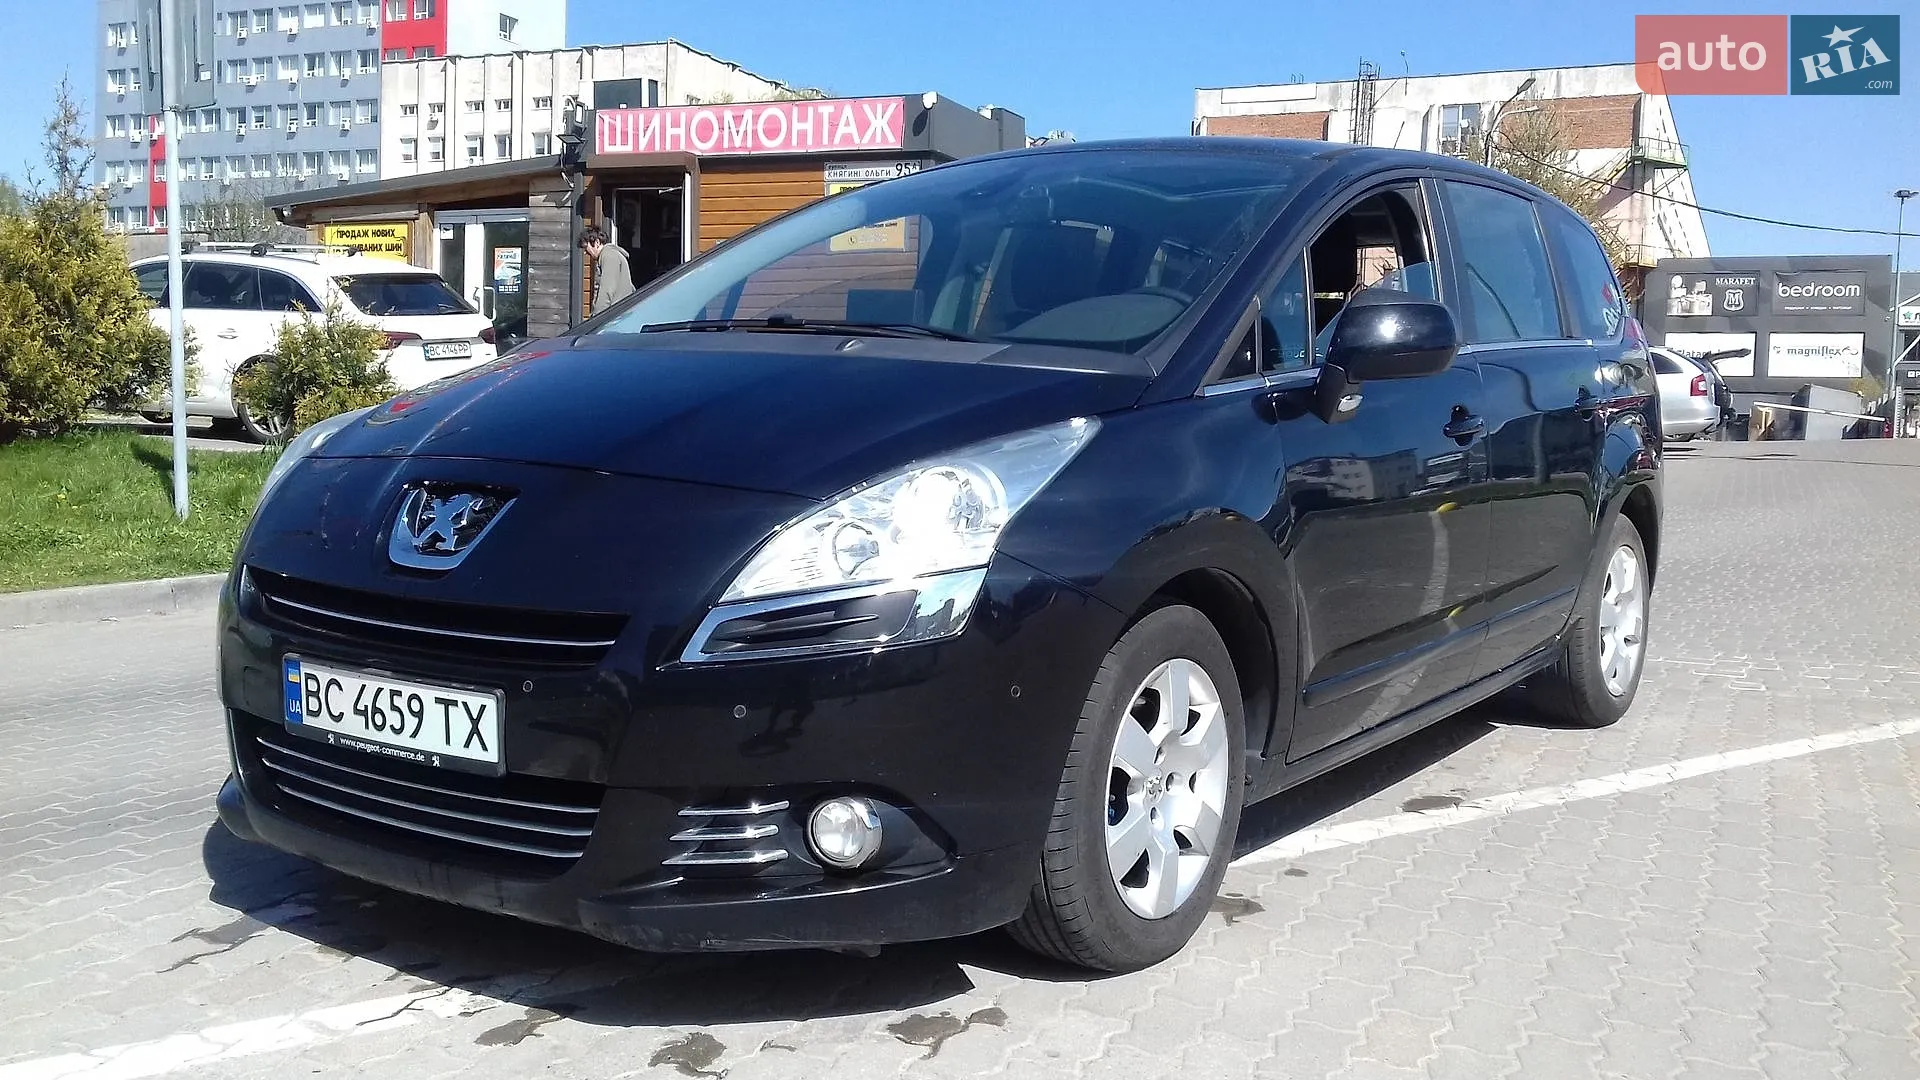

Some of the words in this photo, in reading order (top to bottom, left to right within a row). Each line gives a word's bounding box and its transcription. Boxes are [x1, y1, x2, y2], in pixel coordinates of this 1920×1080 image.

[603, 102, 897, 150] ШИНОМОНТАЖ
[827, 169, 861, 178] КНЯГИНІ
[864, 168, 891, 177] ОЛЬГИ
[336, 228, 370, 240] ПРОДАЖ
[371, 228, 396, 238] НОВИХ
[385, 243, 402, 252] ШИН
[1715, 277, 1756, 286] MARAFET
[1778, 281, 1861, 298] bedroom
[429, 345, 441, 356] BC
[1786, 345, 1842, 357] magniflex
[289, 698, 302, 715] UA
[304, 671, 345, 723] BC
[352, 682, 425, 739] 4659
[434, 696, 489, 752] TX
[339, 736, 426, 763] www.peugeot-commerce.de
